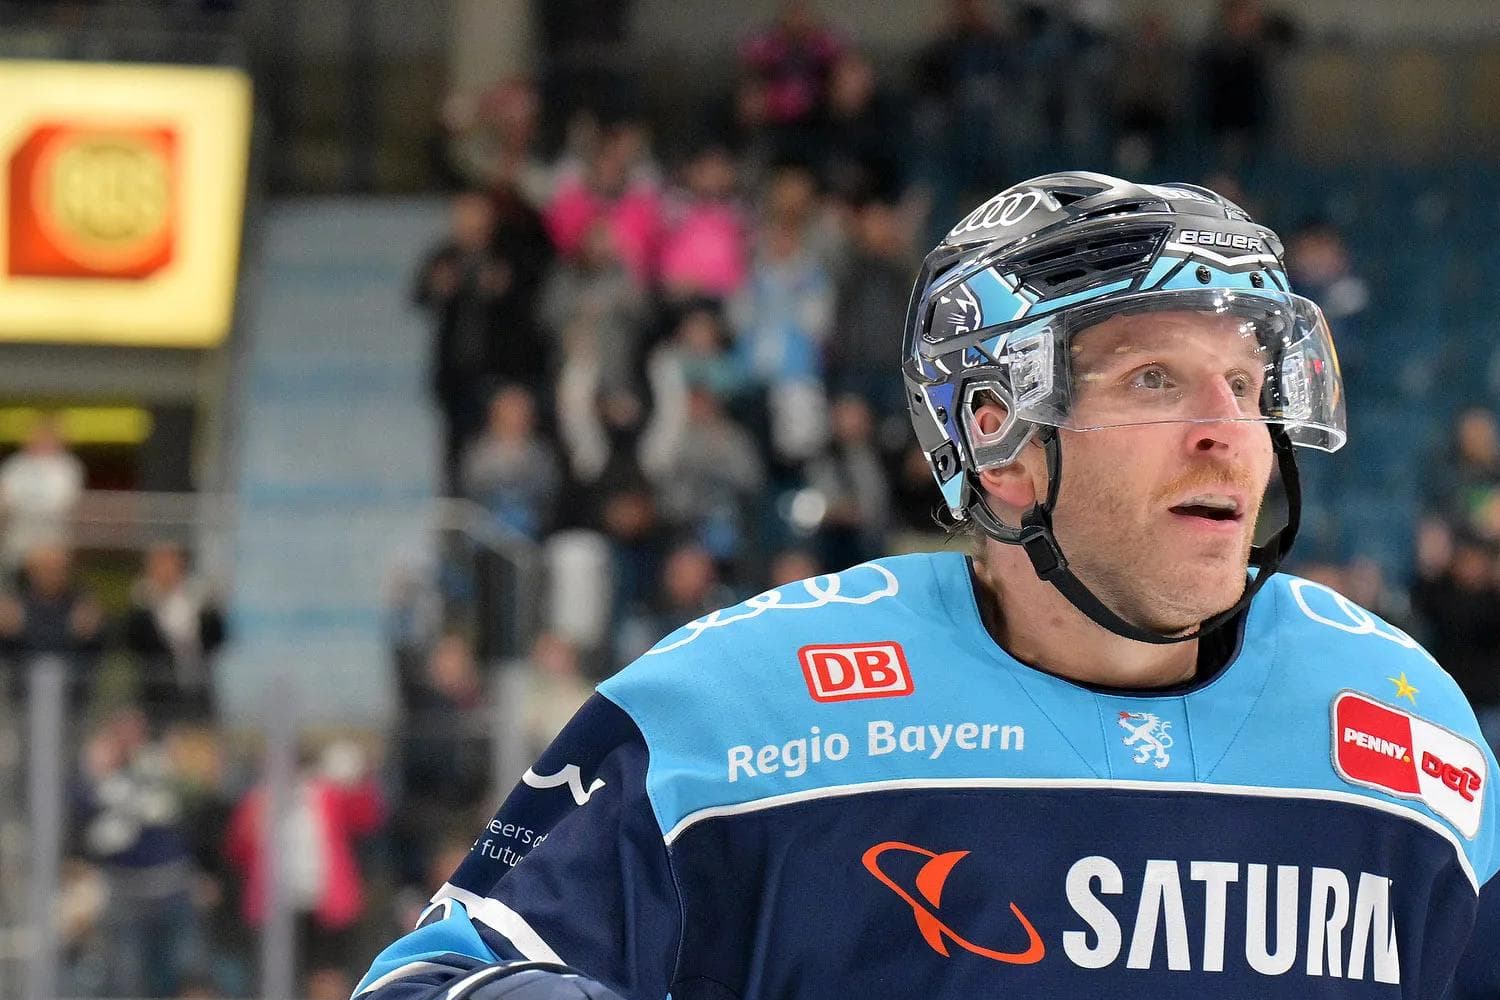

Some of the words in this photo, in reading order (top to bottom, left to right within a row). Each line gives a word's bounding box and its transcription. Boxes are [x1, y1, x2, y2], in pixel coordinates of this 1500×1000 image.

[811, 650, 898, 693] DB
[728, 726, 850, 783] Regio
[868, 720, 1025, 760] Bayern
[486, 817, 534, 845] eers
[481, 839, 524, 868] futu
[1062, 855, 1400, 985] SATURN
